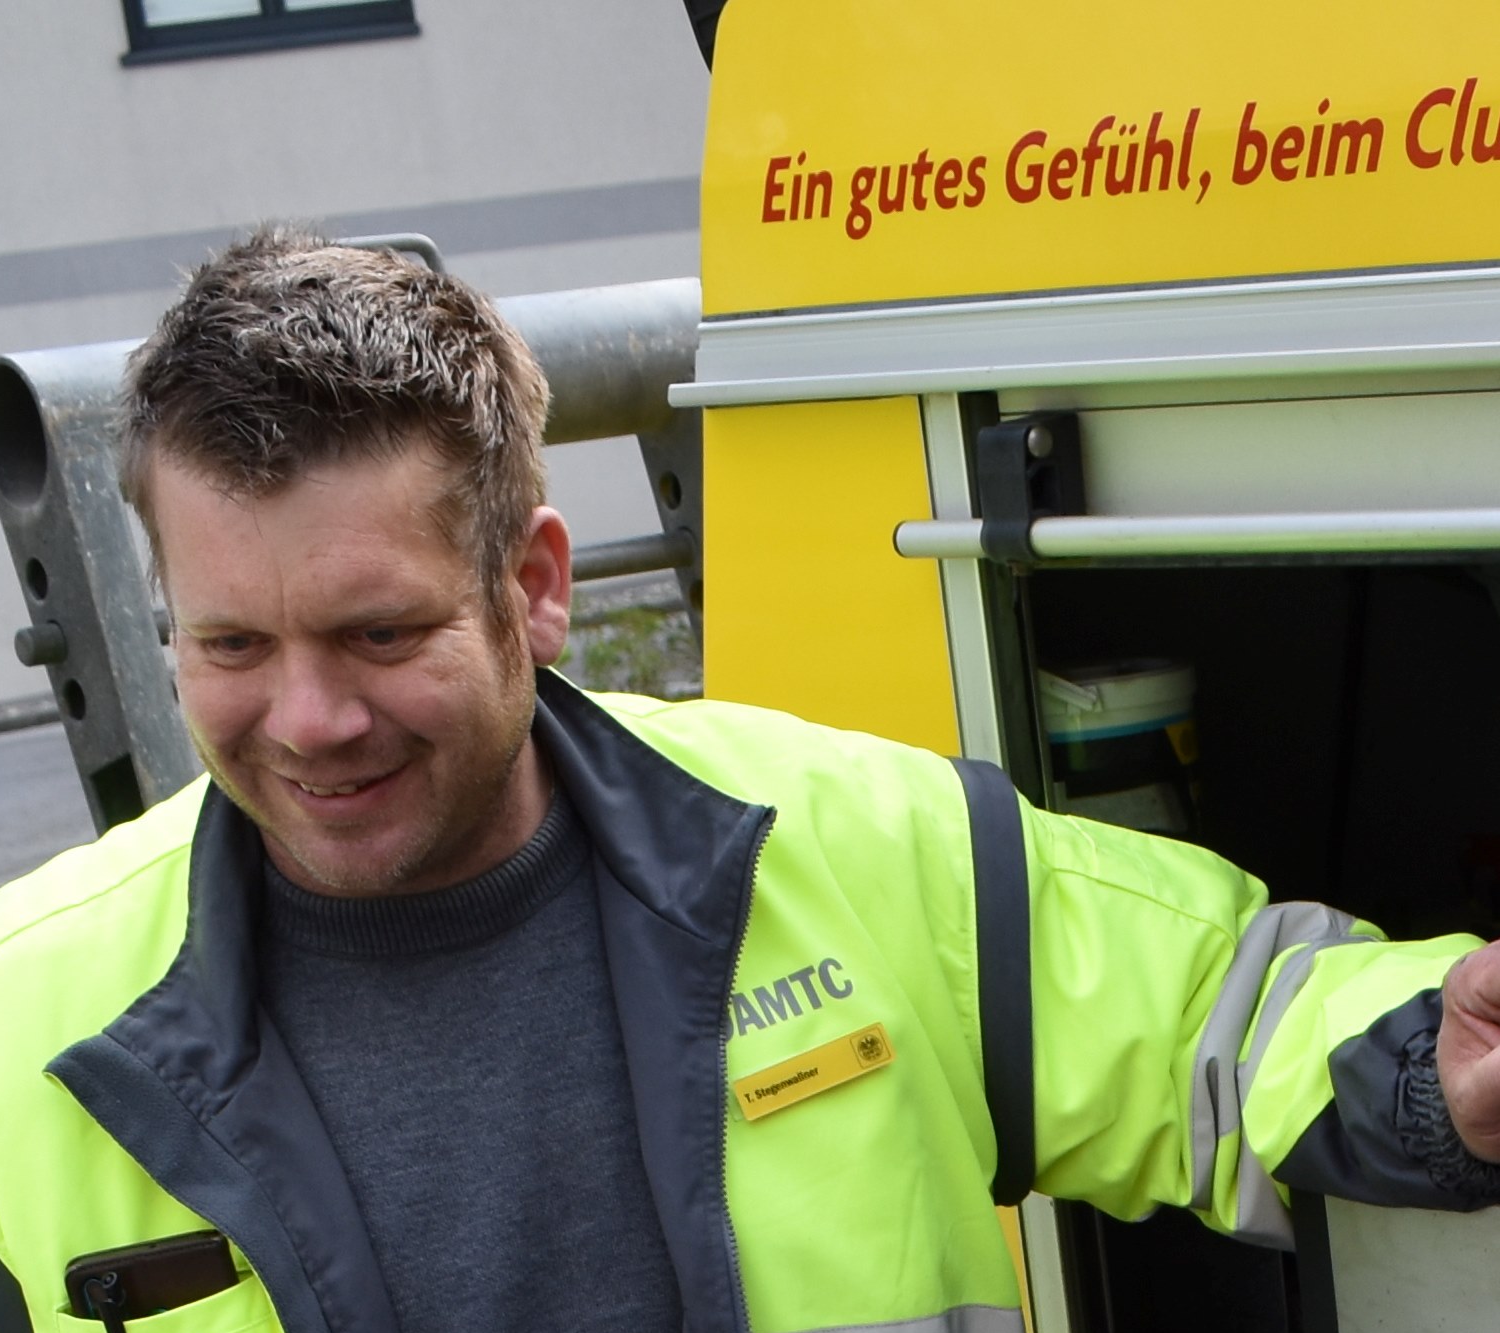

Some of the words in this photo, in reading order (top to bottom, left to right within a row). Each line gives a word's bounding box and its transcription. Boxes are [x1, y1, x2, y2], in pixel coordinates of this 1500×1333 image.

[761, 152, 835, 225] Ein
[845, 151, 988, 241] gutes
[1005, 107, 1213, 209] Gefühl,
[1230, 98, 1386, 187] beim
[726, 957, 854, 1042] AMTC
